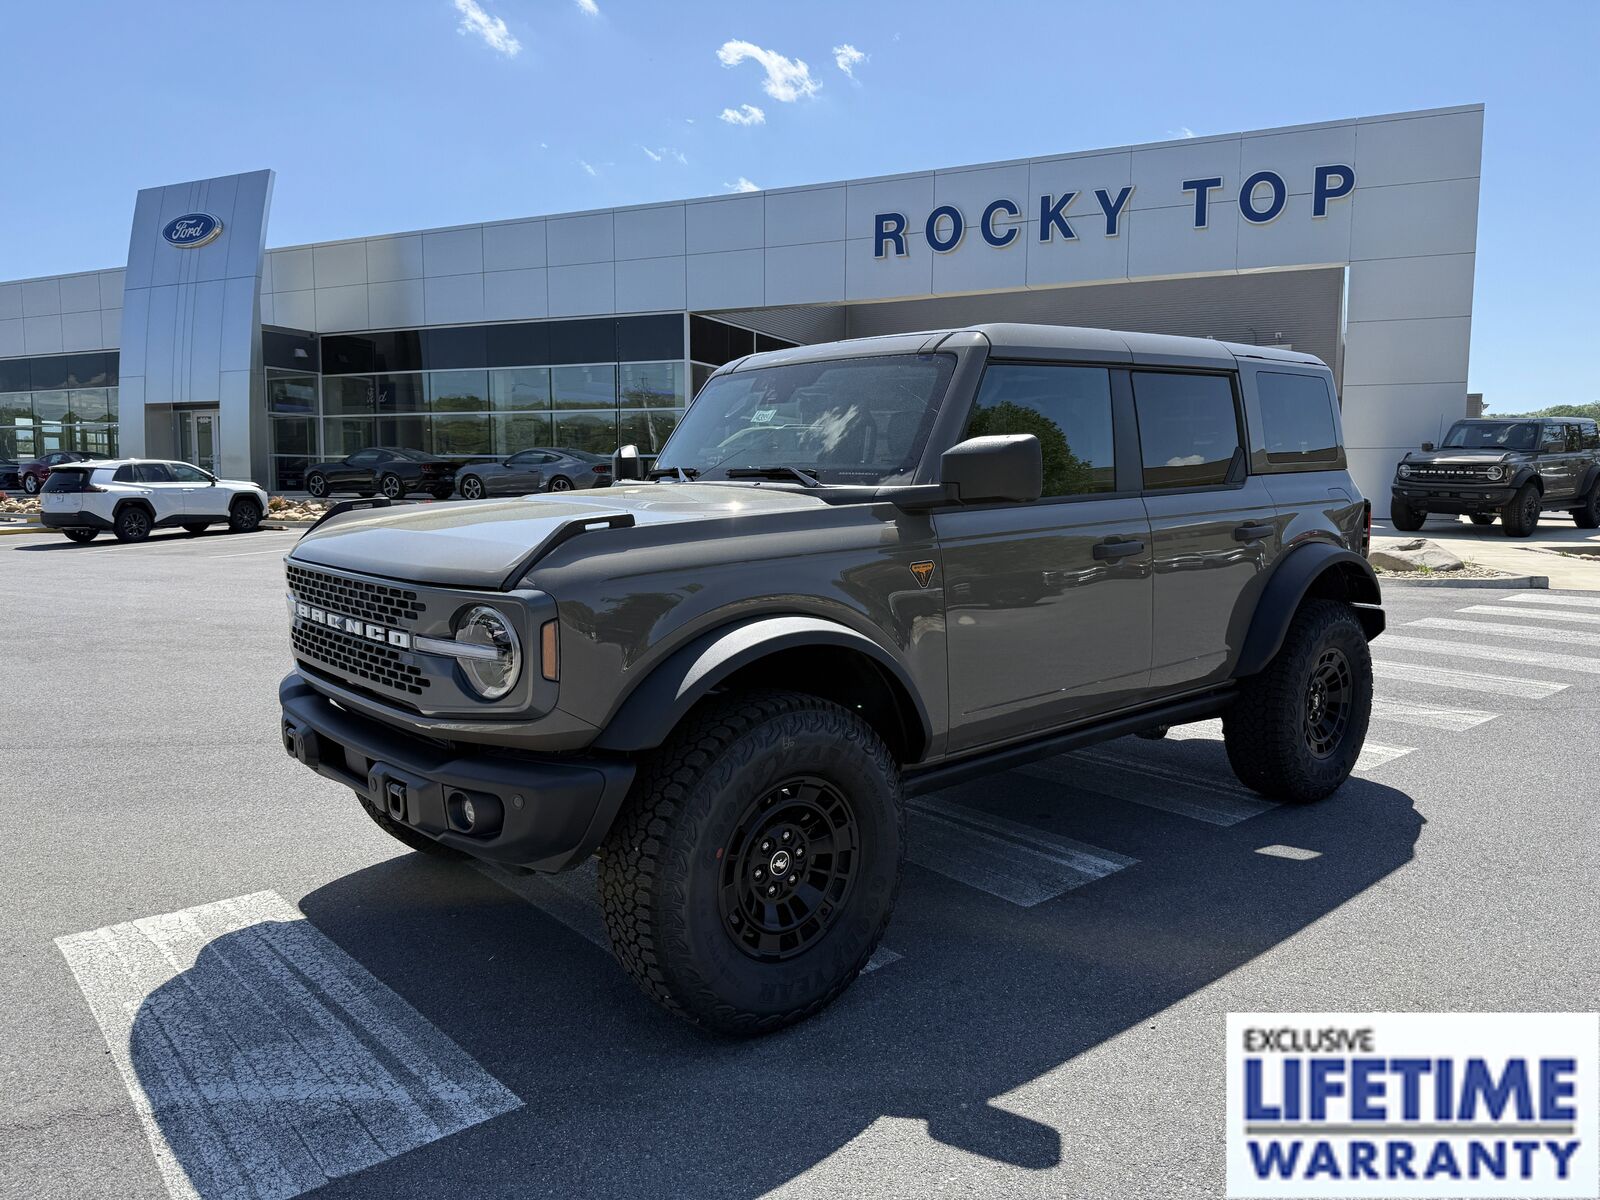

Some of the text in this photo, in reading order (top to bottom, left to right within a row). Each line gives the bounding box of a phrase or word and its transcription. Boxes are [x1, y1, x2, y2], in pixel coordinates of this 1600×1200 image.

[172, 219, 204, 240] Ford
[874, 163, 1357, 258] ROCKY TOP
[297, 602, 410, 649] BRONCO
